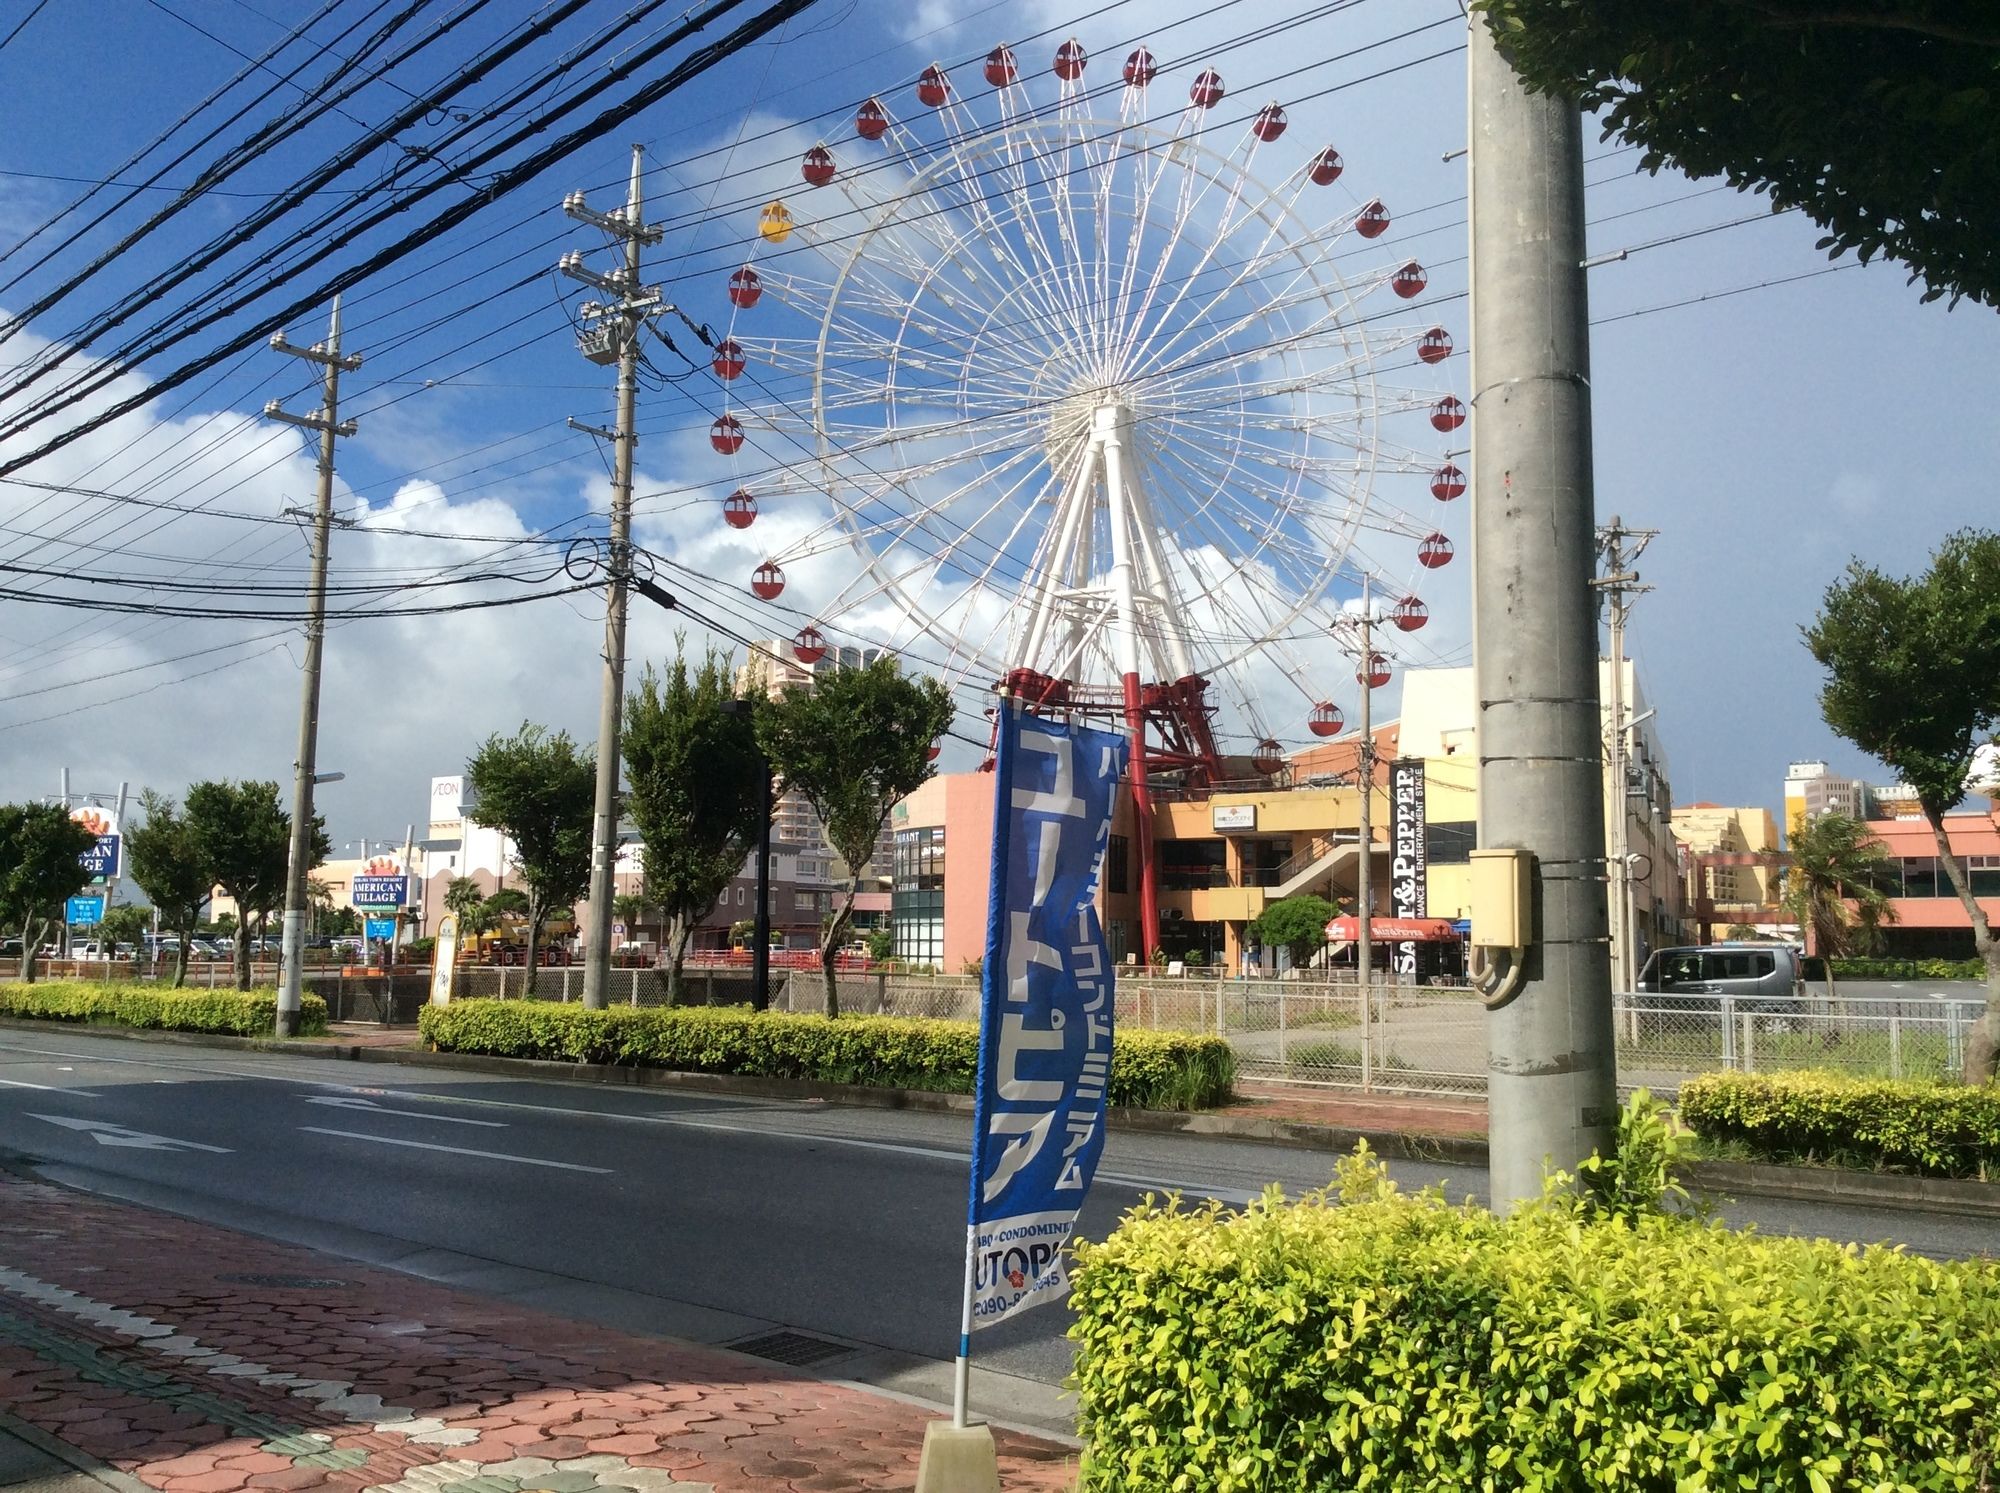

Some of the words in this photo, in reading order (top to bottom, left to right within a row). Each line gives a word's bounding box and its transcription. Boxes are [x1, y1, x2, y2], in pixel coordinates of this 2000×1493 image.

[1414, 768, 1424, 797] STAGE
[1415, 801, 1425, 871] ENTERTAINMENT
[354, 883, 403, 892] AMERICAN
[356, 893, 397, 902] VILLAGE
[983, 730, 1086, 1203] ユートピア
